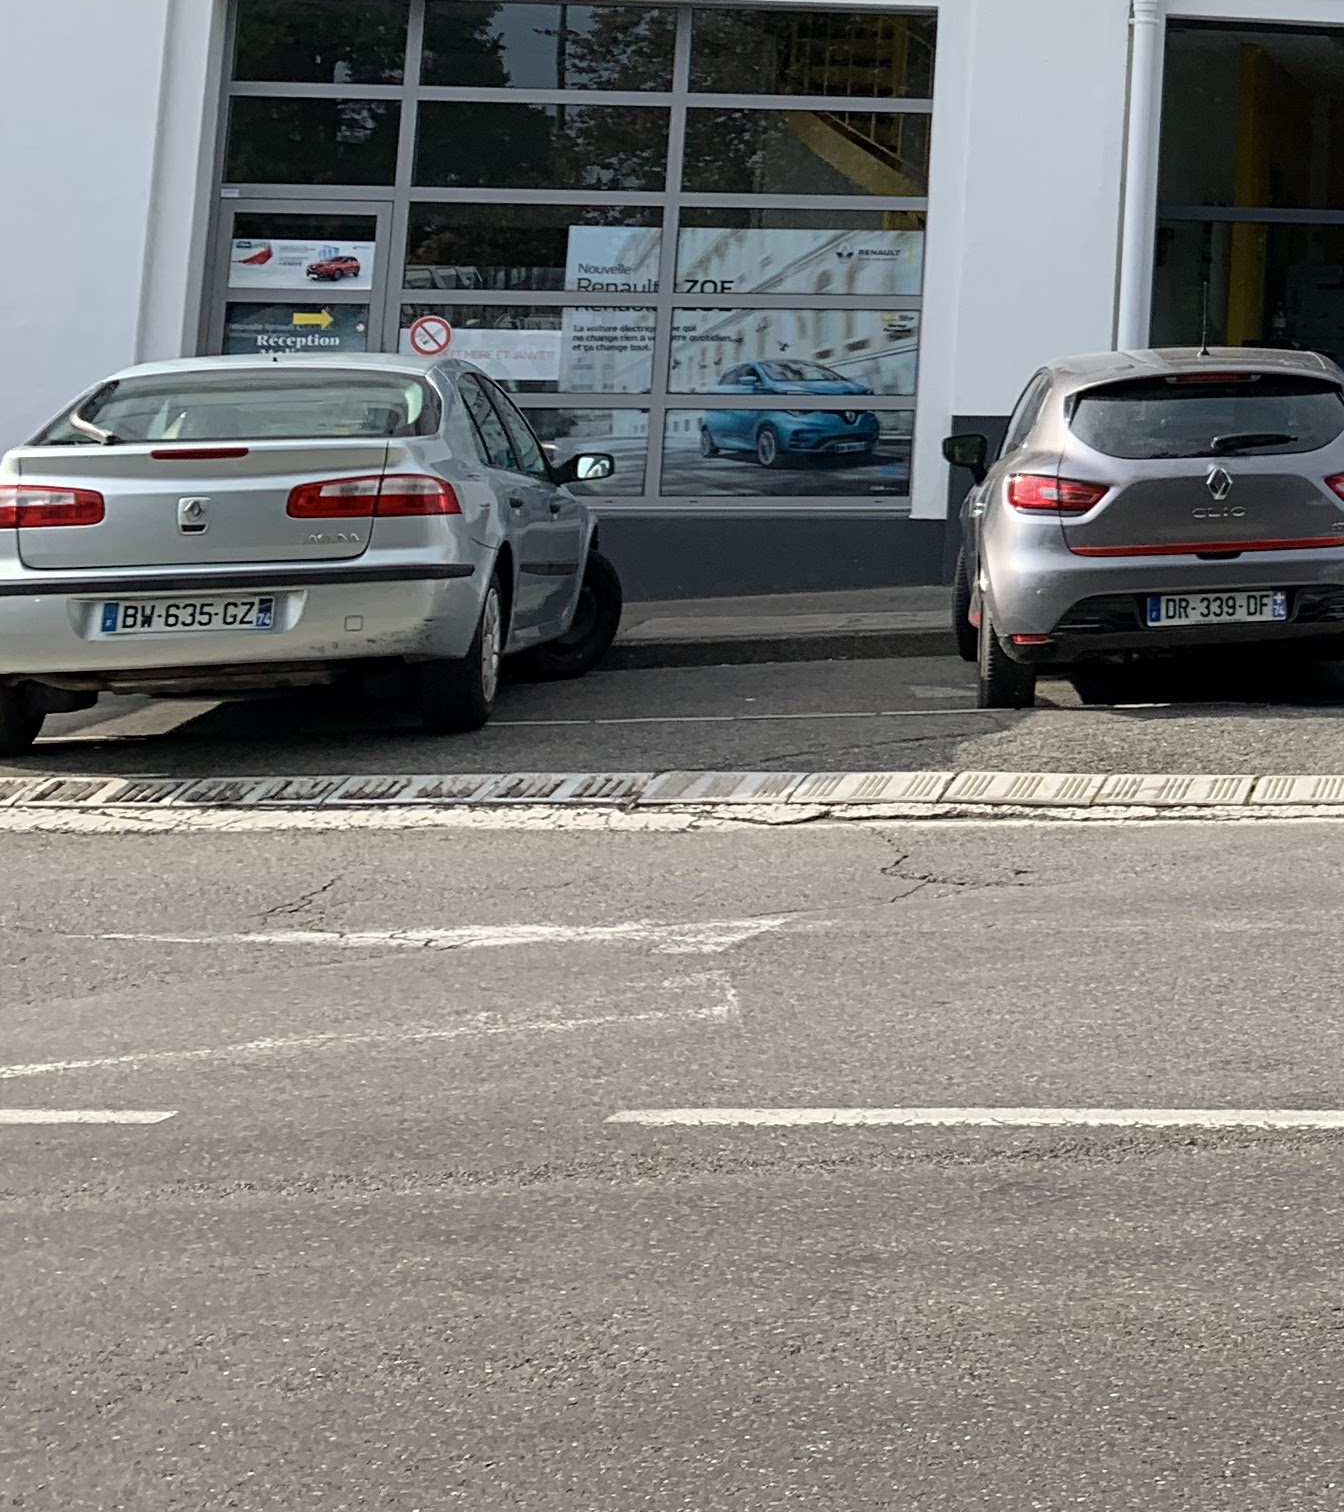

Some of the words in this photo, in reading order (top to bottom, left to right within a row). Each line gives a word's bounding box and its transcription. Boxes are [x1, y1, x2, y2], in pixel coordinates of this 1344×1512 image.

[578, 263, 632, 275] Nouvelle
[256, 333, 340, 349] Réception
[1191, 506, 1246, 518] CLIO
[1165, 594, 1270, 619] DR-339-DF
[122, 601, 256, 629] BW-635-GZ
